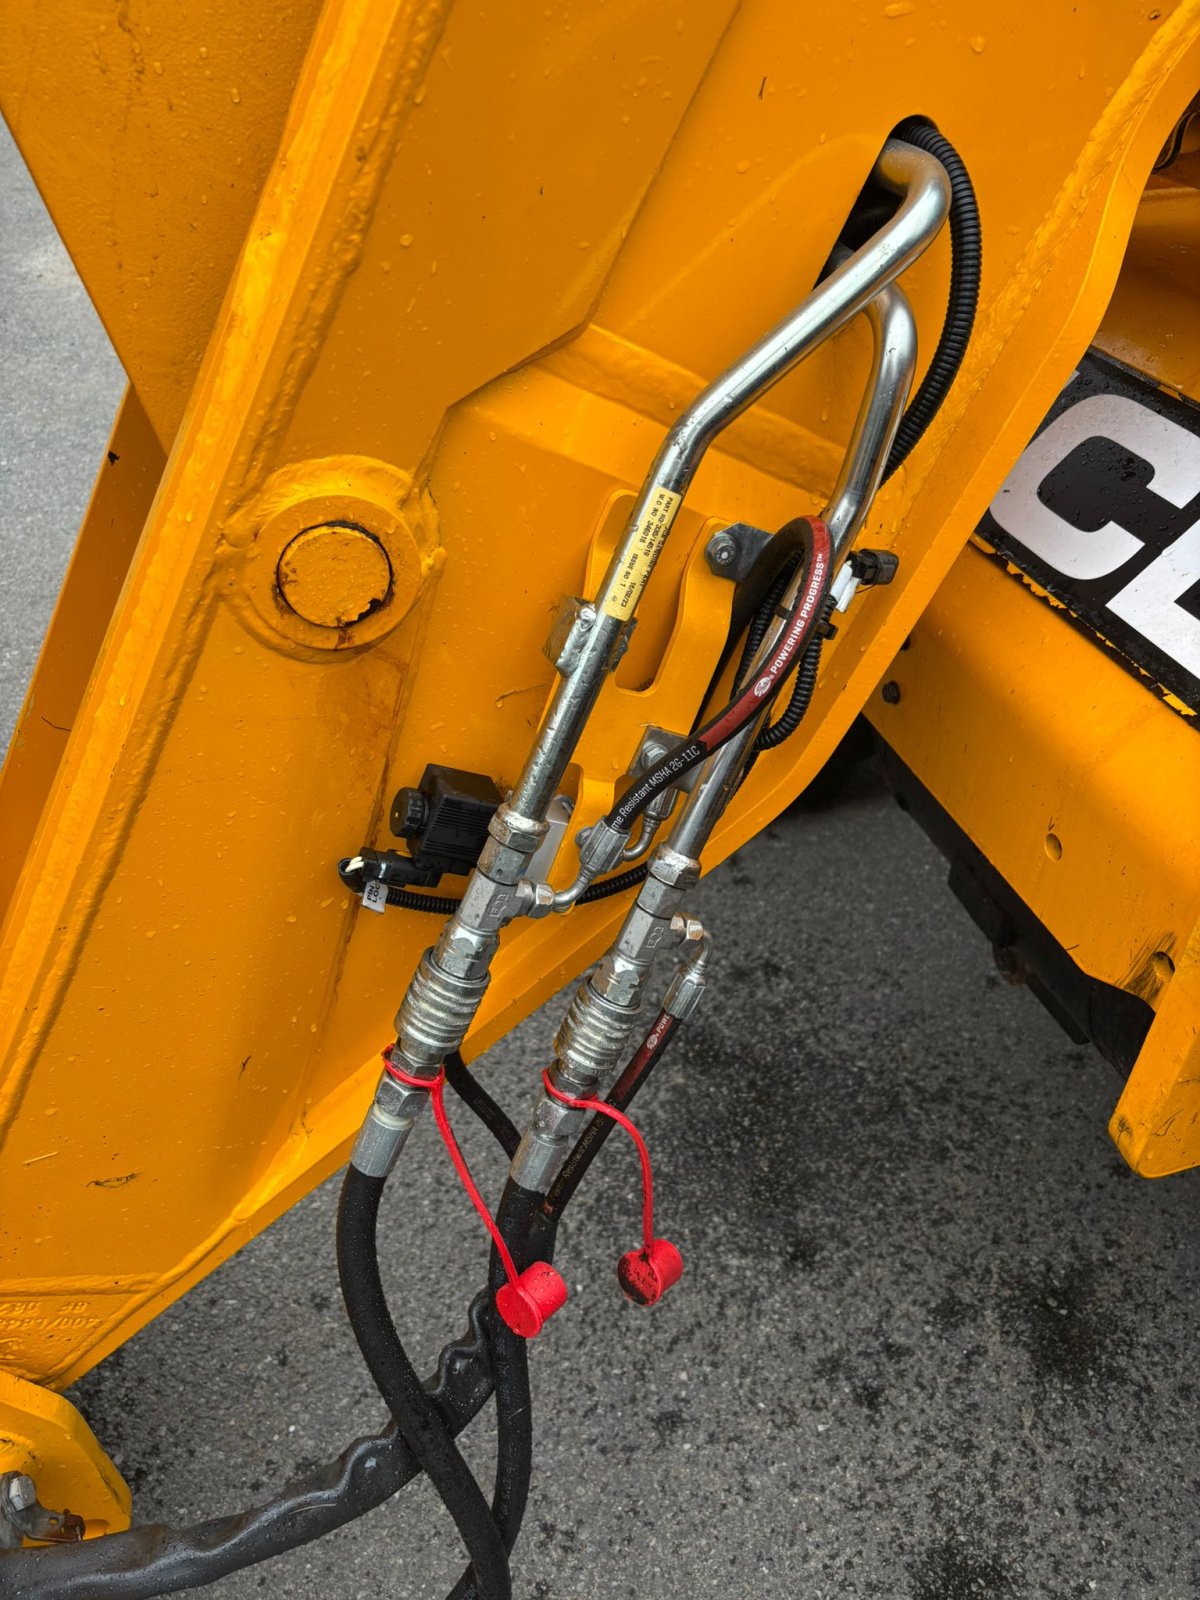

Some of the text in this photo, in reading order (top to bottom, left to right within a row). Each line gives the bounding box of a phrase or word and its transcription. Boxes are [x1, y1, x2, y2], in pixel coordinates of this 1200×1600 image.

[665, 497, 674, 513] PART
[629, 553, 639, 569] ISSUE
[770, 619, 806, 675] POWERING
[619, 781, 652, 818] Resistant
[649, 765, 672, 791] MSHA
[669, 744, 701, 772] 2G-11C
[367, 885, 375, 901] PIN
[372, 880, 381, 903] LOC
